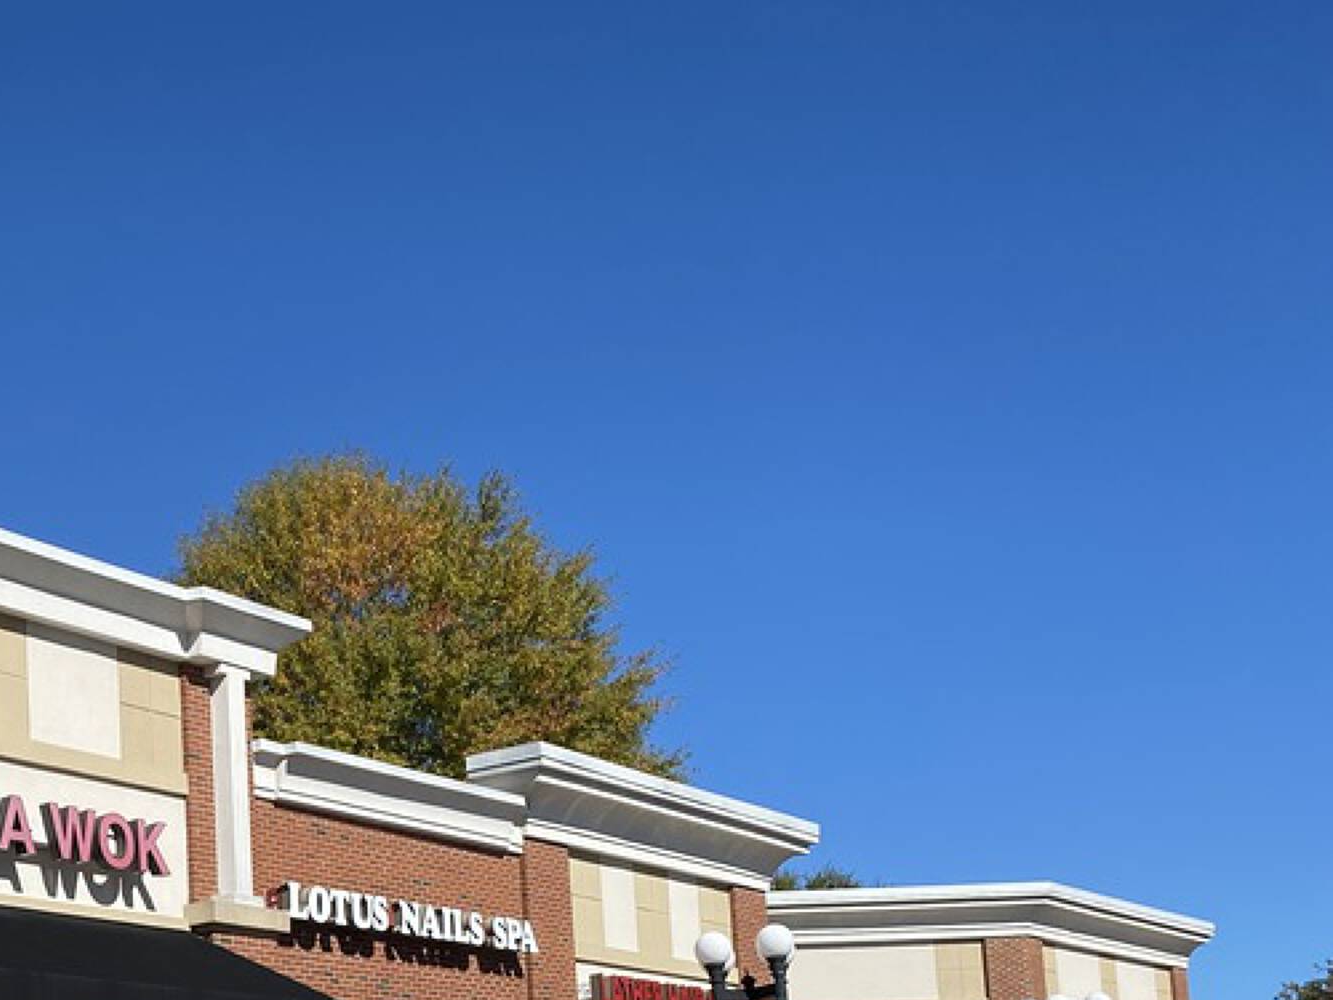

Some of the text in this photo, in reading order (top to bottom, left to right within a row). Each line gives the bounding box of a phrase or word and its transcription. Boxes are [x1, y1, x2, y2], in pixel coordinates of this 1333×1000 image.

[44, 802, 170, 876] WOK
[287, 880, 539, 953] LOTUS NAILS SPA
